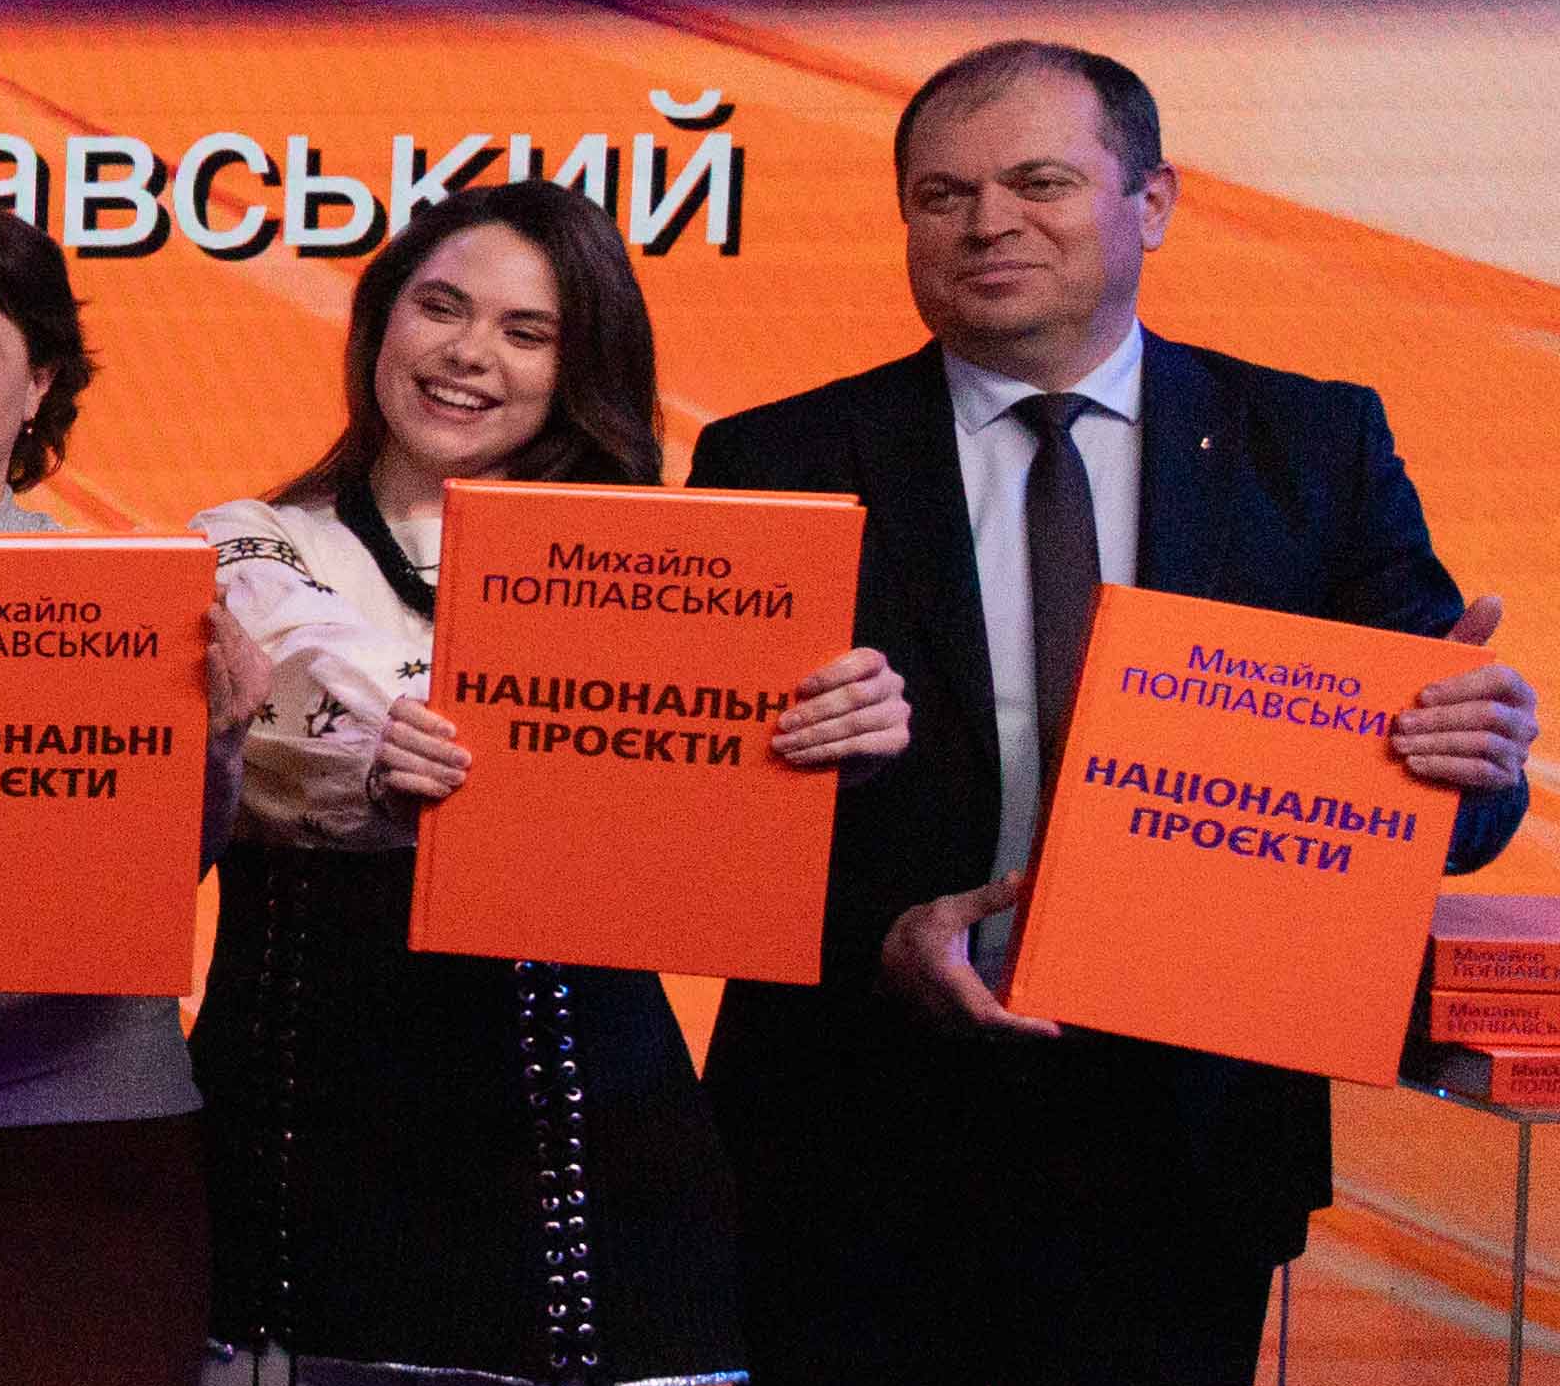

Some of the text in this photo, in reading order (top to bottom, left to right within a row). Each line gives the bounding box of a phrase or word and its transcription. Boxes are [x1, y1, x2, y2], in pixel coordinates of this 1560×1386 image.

[548, 542, 732, 579] Михайло
[482, 574, 793, 620] ПОПЛАВСЬКИЙ
[1188, 644, 1361, 697] Михайло
[455, 671, 789, 723] НАЦІОНАЛЬН
[1121, 666, 1387, 737] ПОПЛАВСЬКИ
[509, 720, 742, 766] ПРОЄКТИ
[1084, 755, 1417, 842] НАЦІОНАЛЬНІ
[1128, 806, 1352, 874] ПРОЄКТИ
